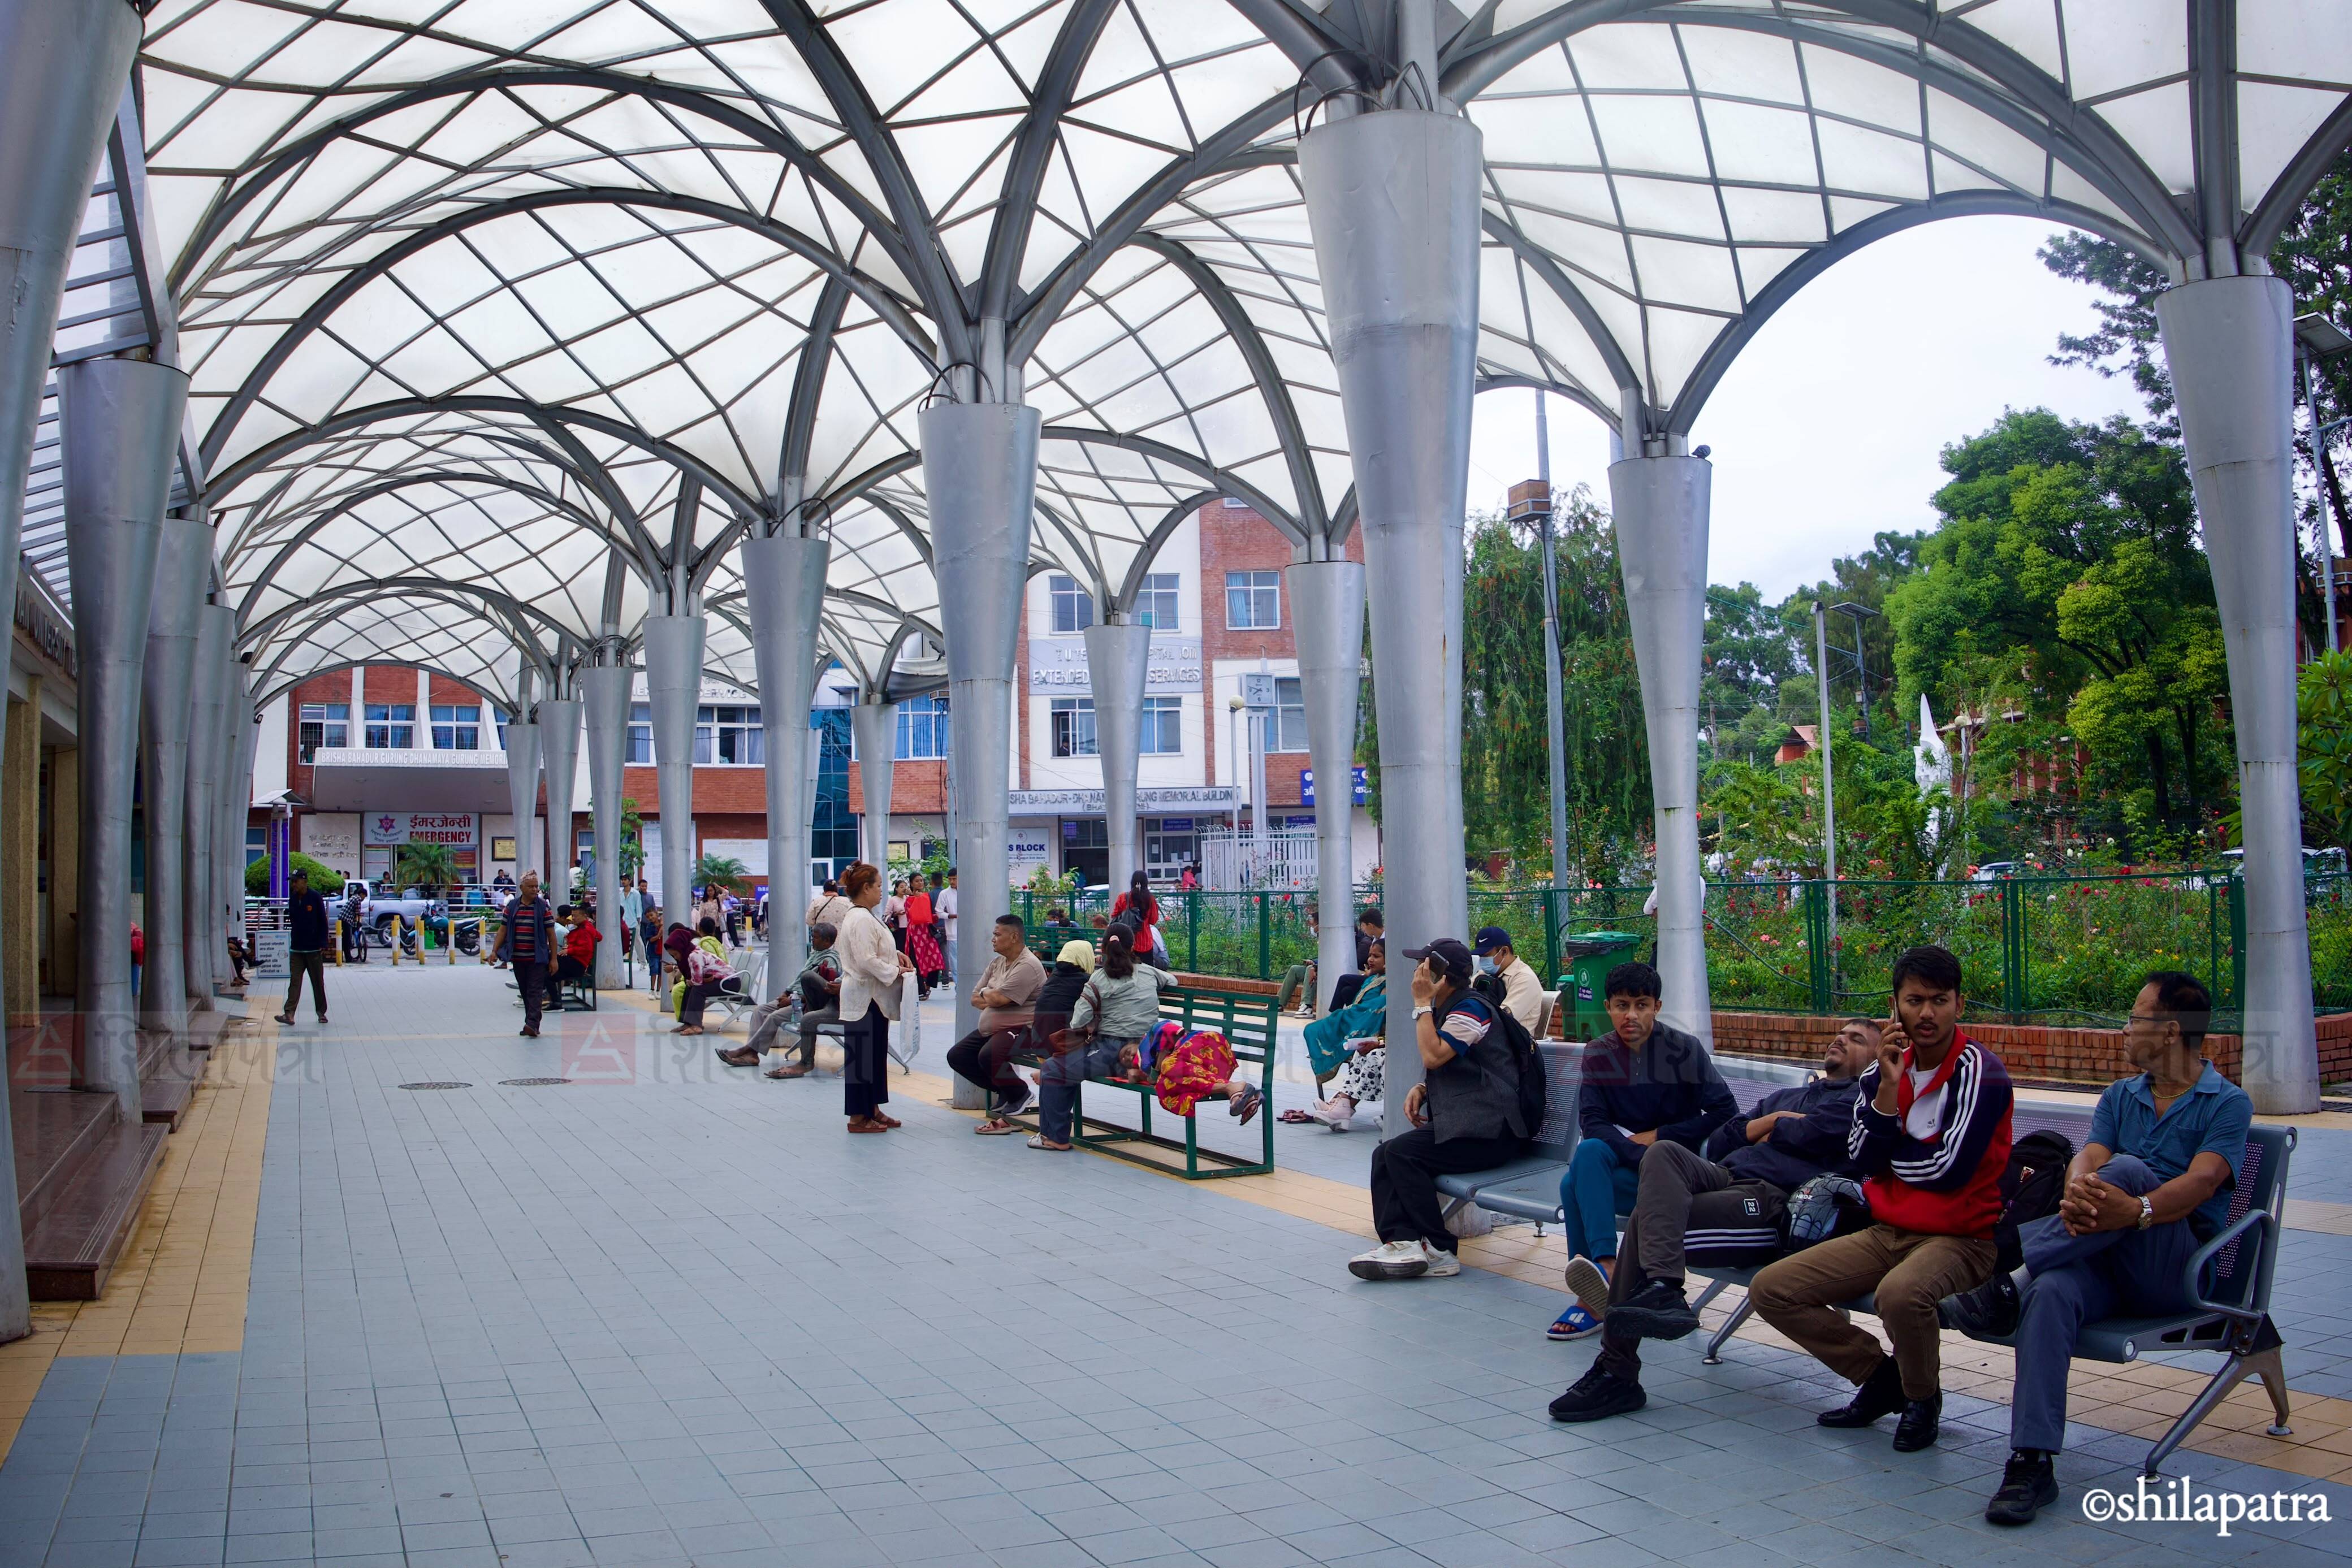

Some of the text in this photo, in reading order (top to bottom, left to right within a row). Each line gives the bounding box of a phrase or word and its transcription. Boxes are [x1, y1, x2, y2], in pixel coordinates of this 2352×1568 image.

[1033, 667, 1200, 685] EXTENDED SERVICES
[321, 751, 346, 763] BRISHA
[348, 751, 379, 764] BAHADUR
[381, 752, 408, 764] GURUNG
[410, 752, 449, 765] DHANAMAYA
[451, 753, 478, 765] GURUNG
[1203, 790, 1238, 801] BUILDIN
[409, 814, 472, 829] ईमरजेन्सी
[409, 831, 472, 843] EMERGENCY
[1748, 1201, 1756, 1212] 22
